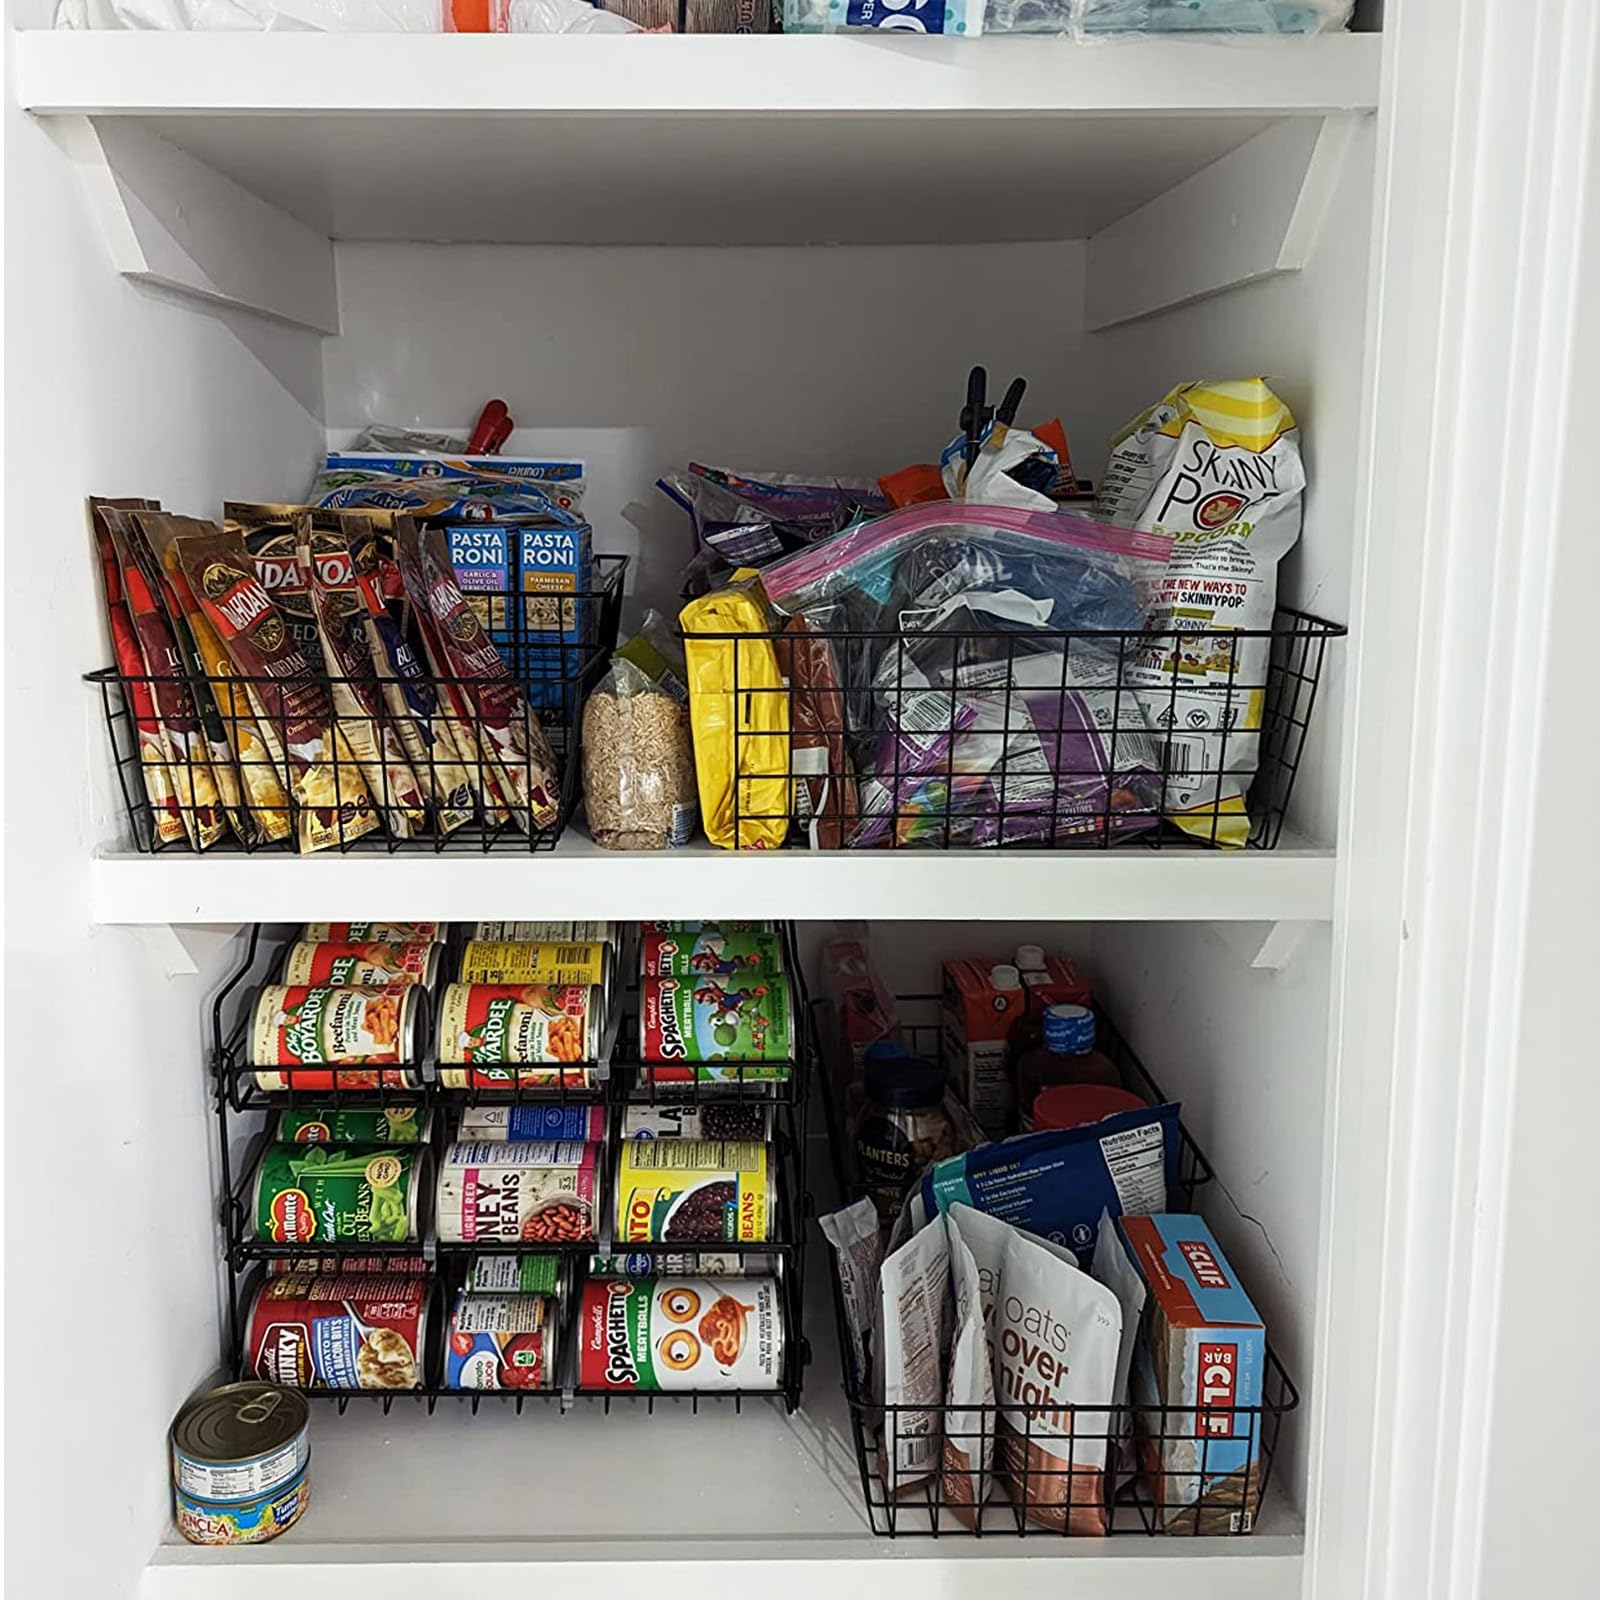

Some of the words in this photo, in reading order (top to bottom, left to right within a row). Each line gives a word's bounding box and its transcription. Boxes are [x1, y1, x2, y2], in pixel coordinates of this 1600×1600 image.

[1182, 439, 1280, 491] SKINNY
[451, 532, 503, 548] PASTA
[523, 533, 575, 549] PASTA
[1152, 522, 1256, 545] OPCORN
[451, 547, 504, 565] RONI
[523, 548, 575, 566] RONI
[462, 577, 484, 585] OLIVE
[486, 578, 498, 586] OIL
[463, 571, 489, 579] GARLIC
[529, 576, 571, 585] PARMESAN
[535, 583, 566, 591] CHEESE
[1178, 579, 1201, 592] NEW
[1200, 581, 1233, 595] WAYS
[1233, 584, 1247, 596] TO
[300, 986, 333, 1064] BOYARDEE
[329, 993, 352, 1054] Beefaroni
[682, 988, 692, 1040] MEATBALLS
[286, 1026, 302, 1057] Chef
[484, 999, 512, 1081] BYARDEE
[1101, 1132, 1137, 1147] Nutrition
[1136, 1126, 1161, 1138] Facts
[857, 1139, 911, 1168] PLANTERS
[375, 1162, 385, 1180] NON
[1110, 1162, 1137, 1174] Calories
[313, 1178, 326, 1209] WITH
[464, 1182, 477, 1203] RED
[561, 1176, 572, 1191] 3.5
[283, 1193, 298, 1231] Monte
[355, 1182, 371, 1223] BEANS
[501, 1173, 521, 1236] BEANS
[741, 1191, 755, 1239] BEANS
[341, 1211, 356, 1236] CUT
[463, 1206, 477, 1237] LIGHT
[1188, 1250, 1225, 1286] CLIF
[330, 1318, 343, 1340] BITS
[636, 1295, 648, 1363] MEATBALLS
[1004, 1295, 1069, 1353] oats
[322, 1340, 335, 1379] POTATO
[331, 1341, 345, 1369] BACON
[1001, 1327, 1070, 1389] over
[1202, 1350, 1234, 1365] BAR
[1202, 1366, 1233, 1435] CLF
[181, 1512, 230, 1538] ANCLA
